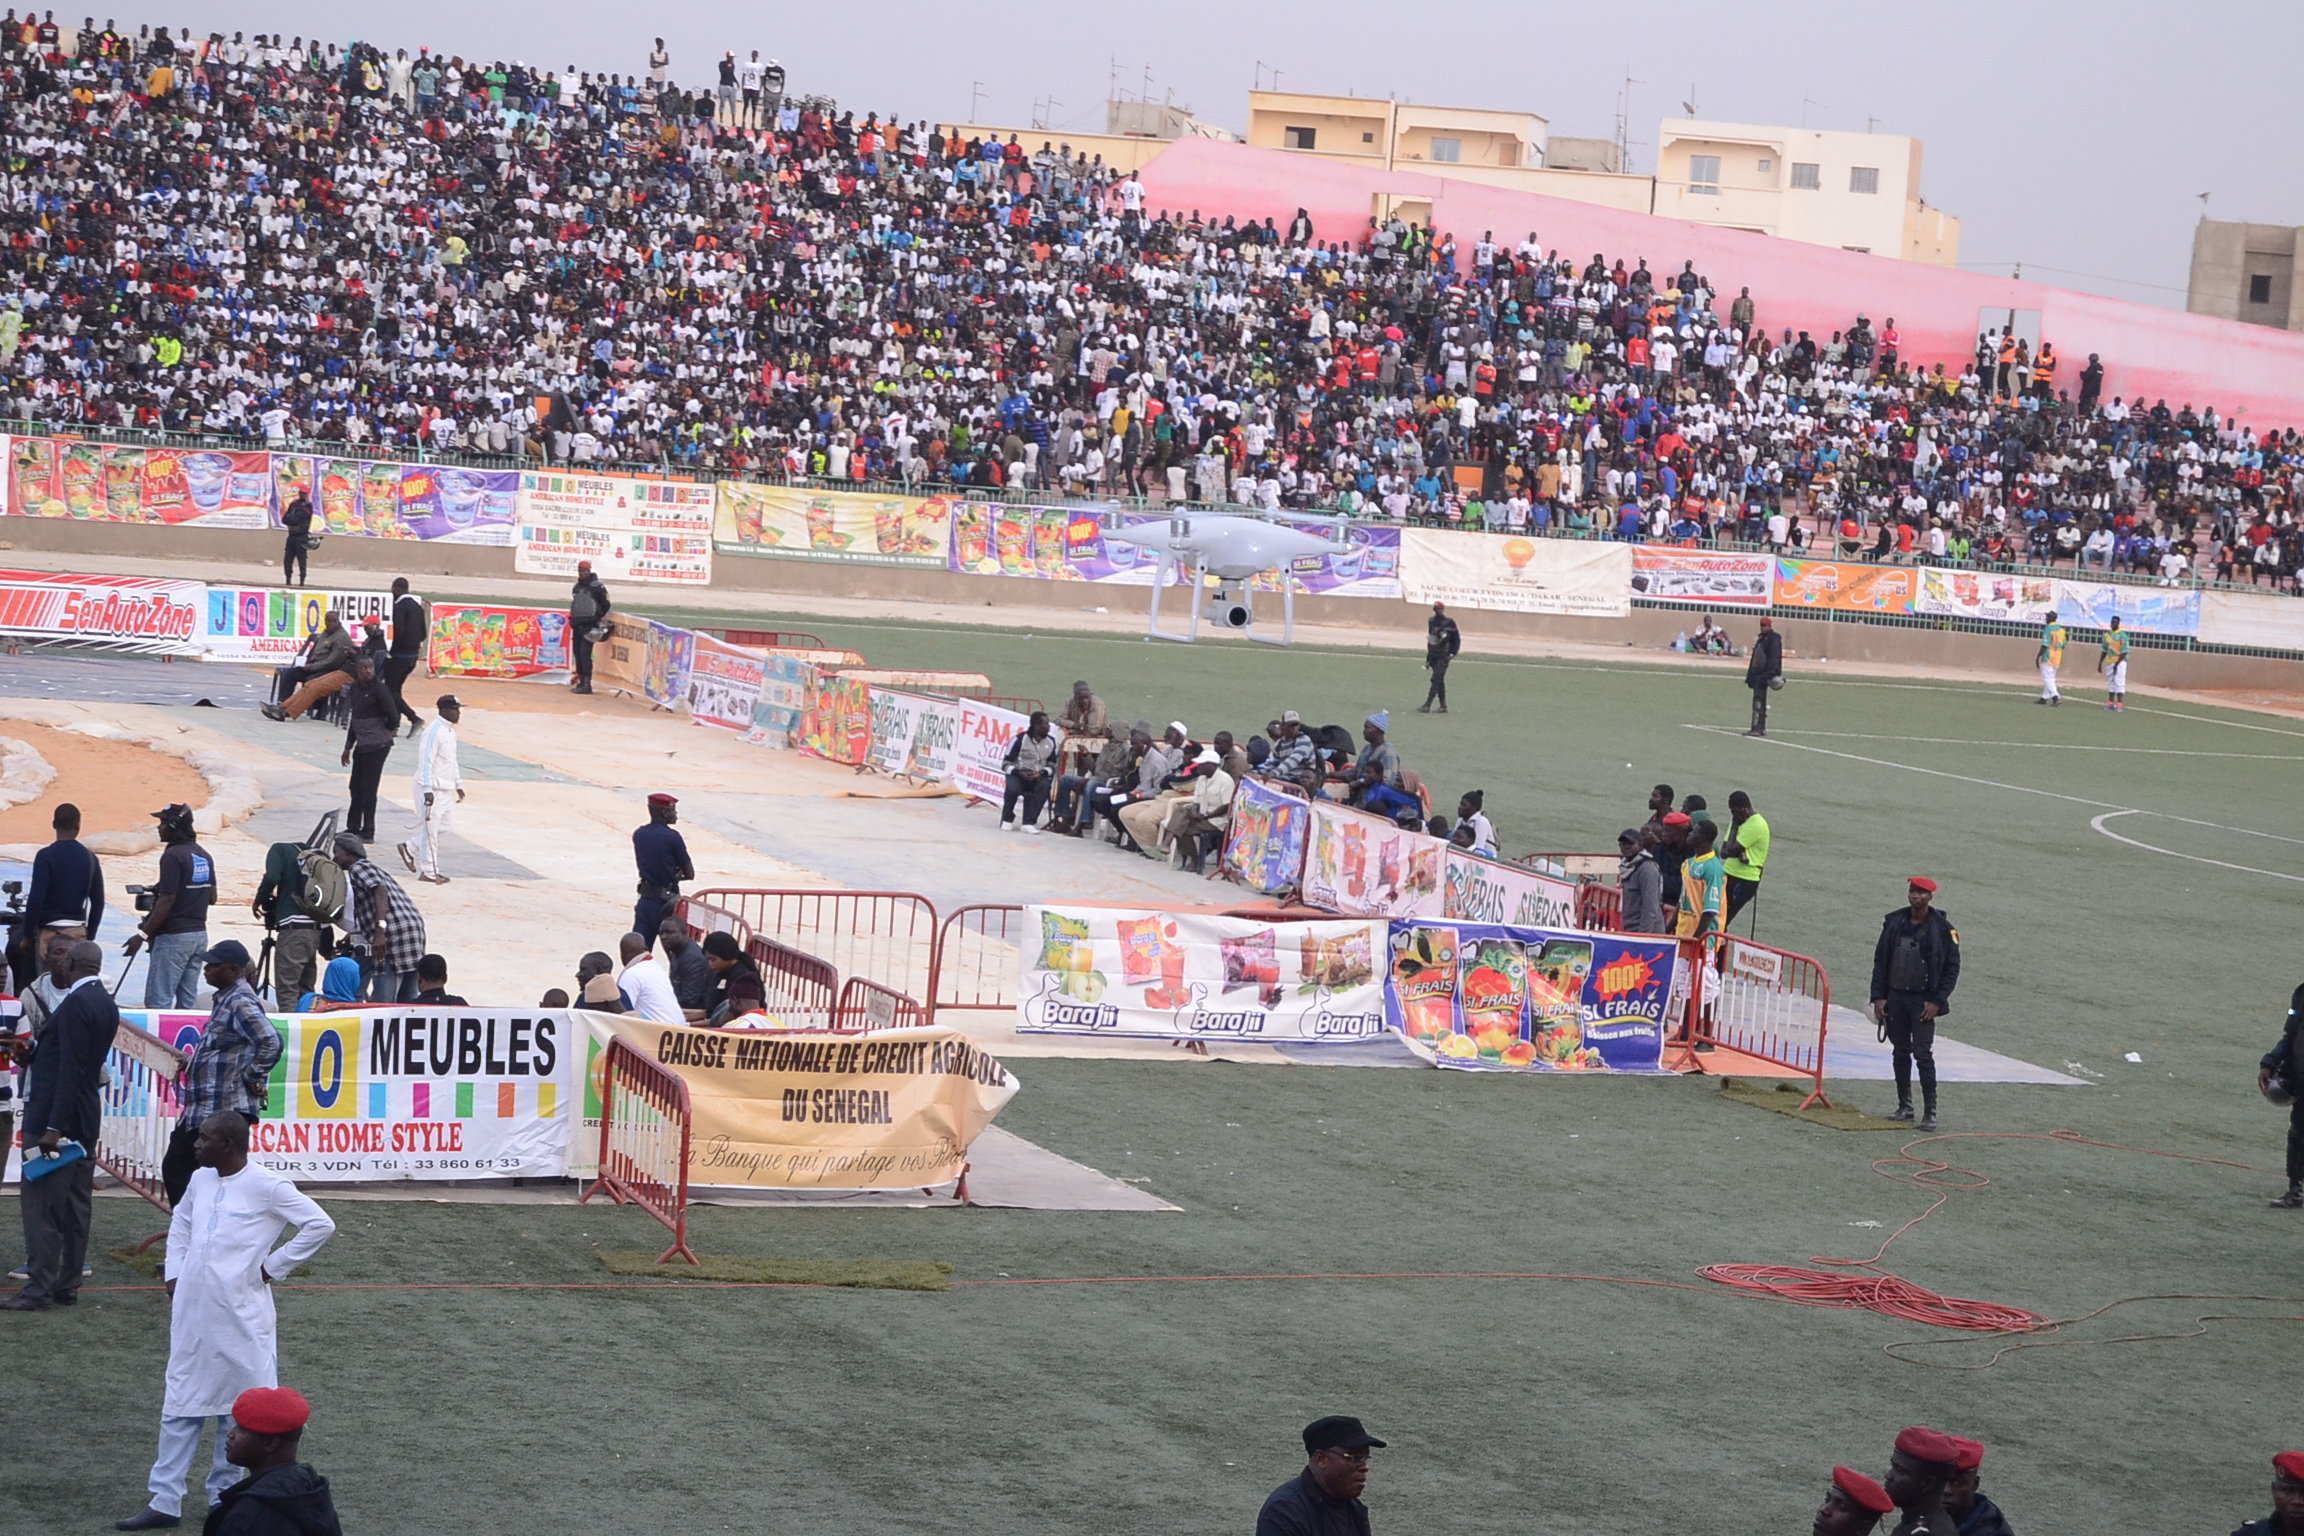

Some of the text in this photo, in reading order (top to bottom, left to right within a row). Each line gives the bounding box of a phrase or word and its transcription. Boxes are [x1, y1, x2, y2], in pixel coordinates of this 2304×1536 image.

[578, 480, 614, 491] MEUBLES
[576, 530, 610, 541] MEUBLES
[1069, 522, 1094, 541] 100F
[1670, 559, 1768, 571] SenAutoZone
[58, 591, 195, 636] SenAutoZone
[513, 646, 534, 656] FRAIS
[1413, 979, 1454, 996] FRAIS
[1601, 963, 1645, 994] 100F
[1466, 993, 1521, 1008] SI FRAIS
[1532, 1005, 1544, 1018] SI
[1583, 1000, 1661, 1021] SI FRAIS
[1587, 1026, 1656, 1041] Boisson aux fruits
[370, 1017, 557, 1077] MEUBLES
[658, 1030, 1007, 1088] CAISSE NATIONALE DE CREDIT AGRICOLE
[782, 1088, 893, 1125] DU SENEGAL
[317, 1122, 385, 1153] HOME
[391, 1121, 463, 1153] STYLE
[308, 1161, 318, 1171] 3
[323, 1161, 362, 1171] VDN
[371, 1159, 398, 1170] Tél
[414, 1159, 434, 1169] 33
[439, 1159, 469, 1169] 860
[475, 1159, 493, 1169] 61
[500, 1158, 521, 1168] 33
[702, 1134, 782, 1181] Banque
[787, 1149, 819, 1182] qui
[817, 1149, 896, 1183] partage
[900, 1151, 927, 1171] vos
